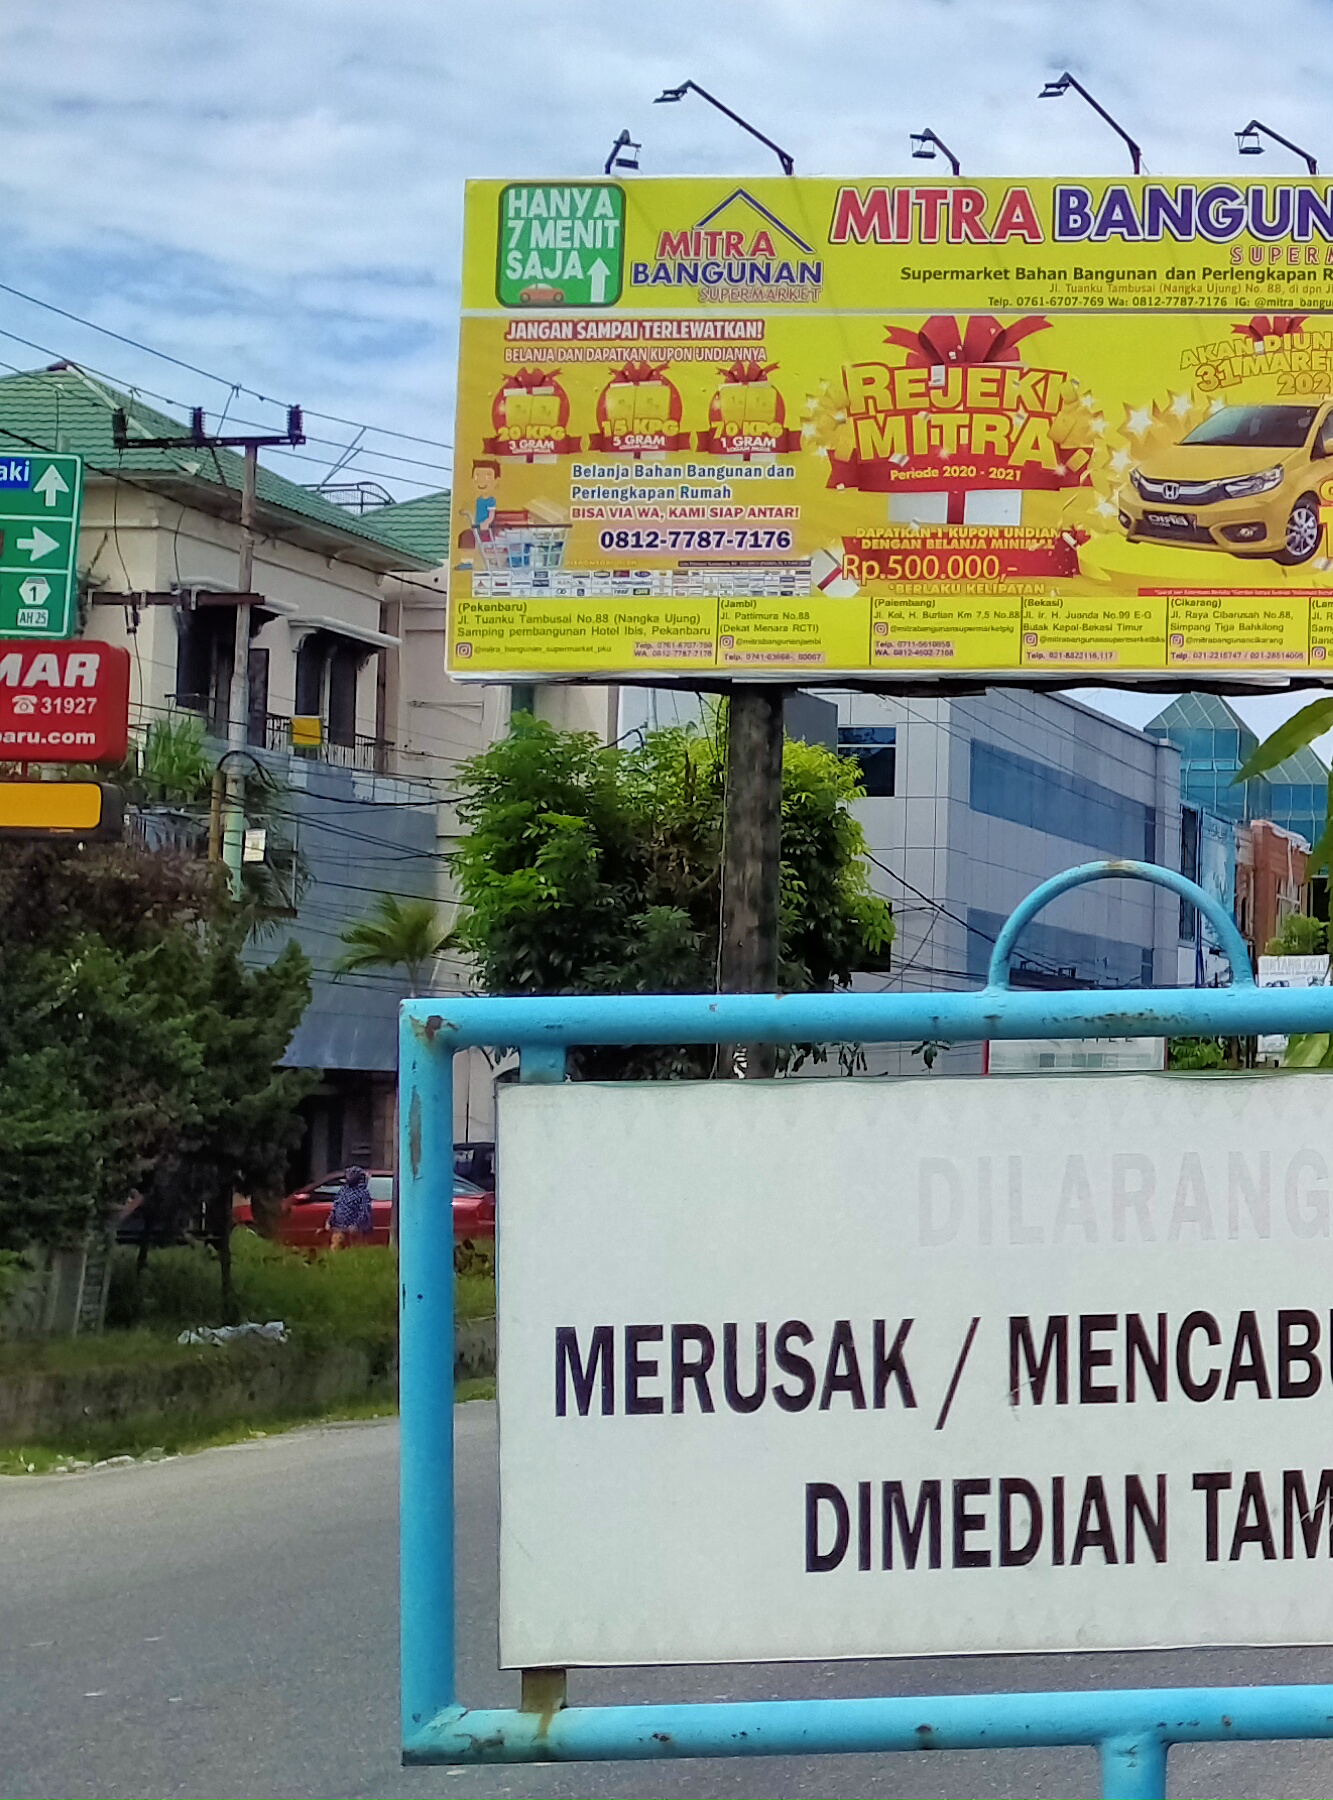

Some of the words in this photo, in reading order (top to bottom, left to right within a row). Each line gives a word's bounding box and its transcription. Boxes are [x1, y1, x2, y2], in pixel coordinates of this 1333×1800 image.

[508, 189, 614, 218] HANYA
[829, 185, 1044, 244] MITRA
[508, 220, 525, 248] 7
[530, 220, 620, 248] MENIT
[657, 230, 777, 259] MITRA
[506, 251, 585, 280] SAJA
[631, 261, 823, 286] BANGUNAN
[900, 266, 1010, 284] Supermarket
[1015, 267, 1067, 281] Bahan
[1074, 267, 1157, 284] Bangunan
[1165, 267, 1197, 281] dan
[1202, 267, 1317, 284] Perlengkapan
[699, 287, 822, 302] SUPERMARKET
[1066, 283, 1103, 293] Tuanku
[1108, 284, 1155, 293] Tambusai
[1159, 283, 1202, 296] (Nangka
[1207, 283, 1242, 296] Ujung)
[1303, 284, 1322, 296] dpn
[1016, 297, 1104, 307] 0761-6707-769
[1108, 297, 1129, 307] Wa:
[1132, 297, 1228, 307] 0812-7787-7176
[506, 321, 573, 340] JANGAN
[577, 321, 639, 340] SAMPAI
[643, 320, 764, 339] TERLEWATKAN!
[505, 347, 555, 362] BELANJA
[558, 347, 582, 361] DAN
[585, 347, 649, 361] DAPATKAN
[651, 347, 692, 362] KUPON
[695, 347, 767, 361] UNDIANNYA
[1180, 337, 1254, 370] AKAN
[1196, 359, 1242, 392] 31
[842, 362, 1067, 415] REJEKI
[498, 426, 522, 441] 20
[601, 420, 627, 438] 15
[633, 418, 680, 436] KPG
[711, 421, 742, 439] 70
[745, 421, 784, 438] KPG
[623, 435, 666, 447] GRAM
[732, 436, 777, 449] GRAM
[854, 412, 1058, 470] MITRA
[571, 464, 630, 481] Belanja
[634, 464, 682, 479] Bahan
[687, 464, 763, 481] Bangunan
[767, 464, 795, 478] dan
[890, 467, 939, 481] Periode
[943, 466, 977, 478] 2020
[989, 467, 1021, 481] 2021
[571, 486, 676, 502] Perlengkapan
[679, 486, 732, 500] Rumah
[571, 507, 605, 519] BISA
[607, 507, 636, 519] VIA
[637, 507, 665, 521] WA,
[669, 507, 707, 519] KAMI
[709, 507, 744, 519] SIAP
[746, 507, 799, 519] ANTAR!
[600, 529, 791, 551] 0812-7787-7176
[856, 527, 931, 538] DAPATKAN
[950, 527, 999, 538] KUPON
[1004, 527, 1061, 538] UNDIAN
[861, 539, 922, 550] DENGAN
[926, 539, 987, 550] BELANJA
[842, 554, 1018, 585] Rp.500.000,-
[29, 586, 37, 602] 1
[965, 583, 1045, 595] KELIPATAN
[458, 602, 527, 613] (Pekanbaru)
[1024, 598, 1063, 609] (Bekasi)
[1171, 598, 1222, 609] (Cikarang)
[20, 612, 33, 624] AH
[35, 612, 47, 624] 25
[475, 615, 514, 624] Tuanku
[519, 614, 572, 624] Tambusai
[614, 614, 659, 626] (Nangka
[665, 614, 700, 626] Ujung)
[1066, 611, 1099, 620] Juanda
[1185, 611, 1209, 621] Raya
[458, 627, 504, 639] Samping
[509, 627, 586, 638] pembangunan
[591, 626, 620, 636] Hotel
[652, 626, 711, 636] Pekanbaru
[720, 624, 750, 634] (Dekat
[753, 624, 788, 633] Menara
[1117, 623, 1143, 632] Timur
[1171, 623, 1211, 633] Simpang
[1215, 623, 1235, 633] Tiga
[41, 698, 97, 714] 31927
[915, 1149, 1332, 1246] DILARANG
[553, 1317, 917, 1417] MERUSAK
[934, 1317, 981, 1430] /
[804, 1473, 1170, 1575] DIMEDIAN
